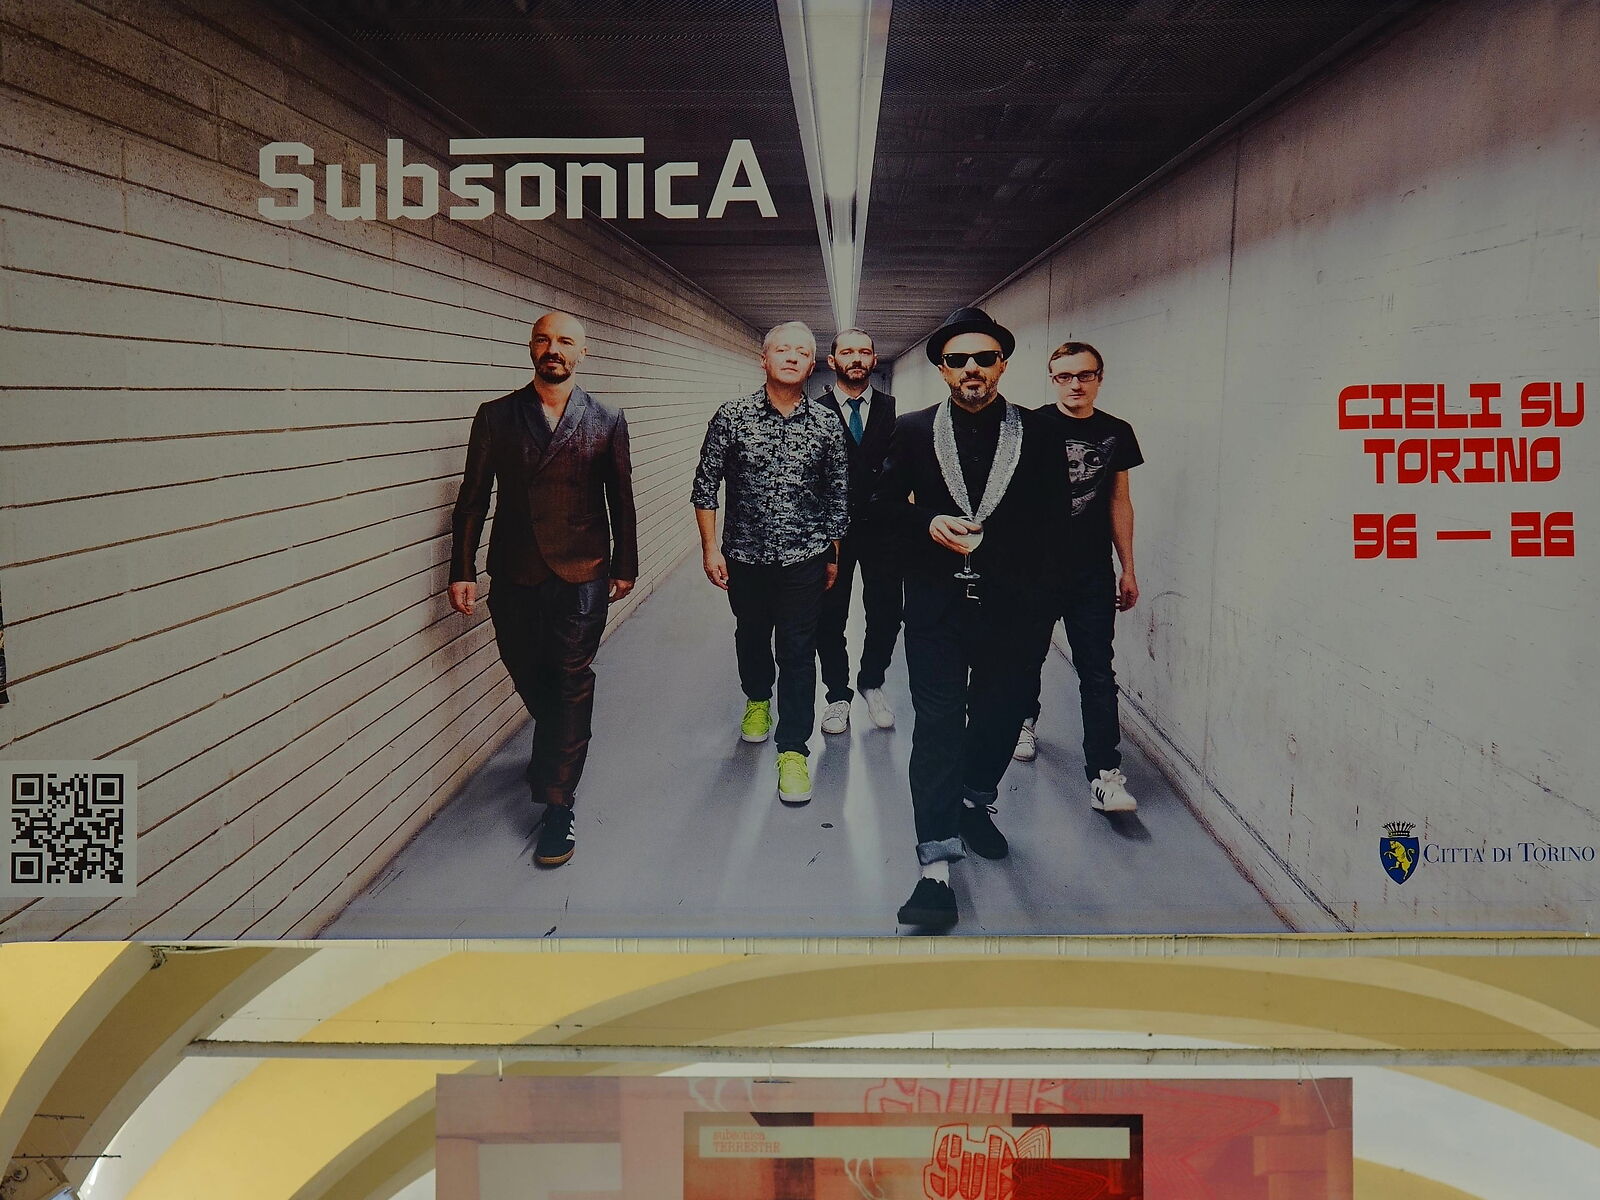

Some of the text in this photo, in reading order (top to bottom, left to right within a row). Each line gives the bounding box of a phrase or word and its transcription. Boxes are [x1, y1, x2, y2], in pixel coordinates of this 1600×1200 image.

[258, 137, 778, 221] SubsonicA
[1338, 382, 1585, 430] CIELI SU
[1363, 437, 1561, 484] TORINO
[1353, 513, 1418, 559] 96
[1510, 511, 1575, 557] 26
[1517, 842, 1596, 863] TORINO
